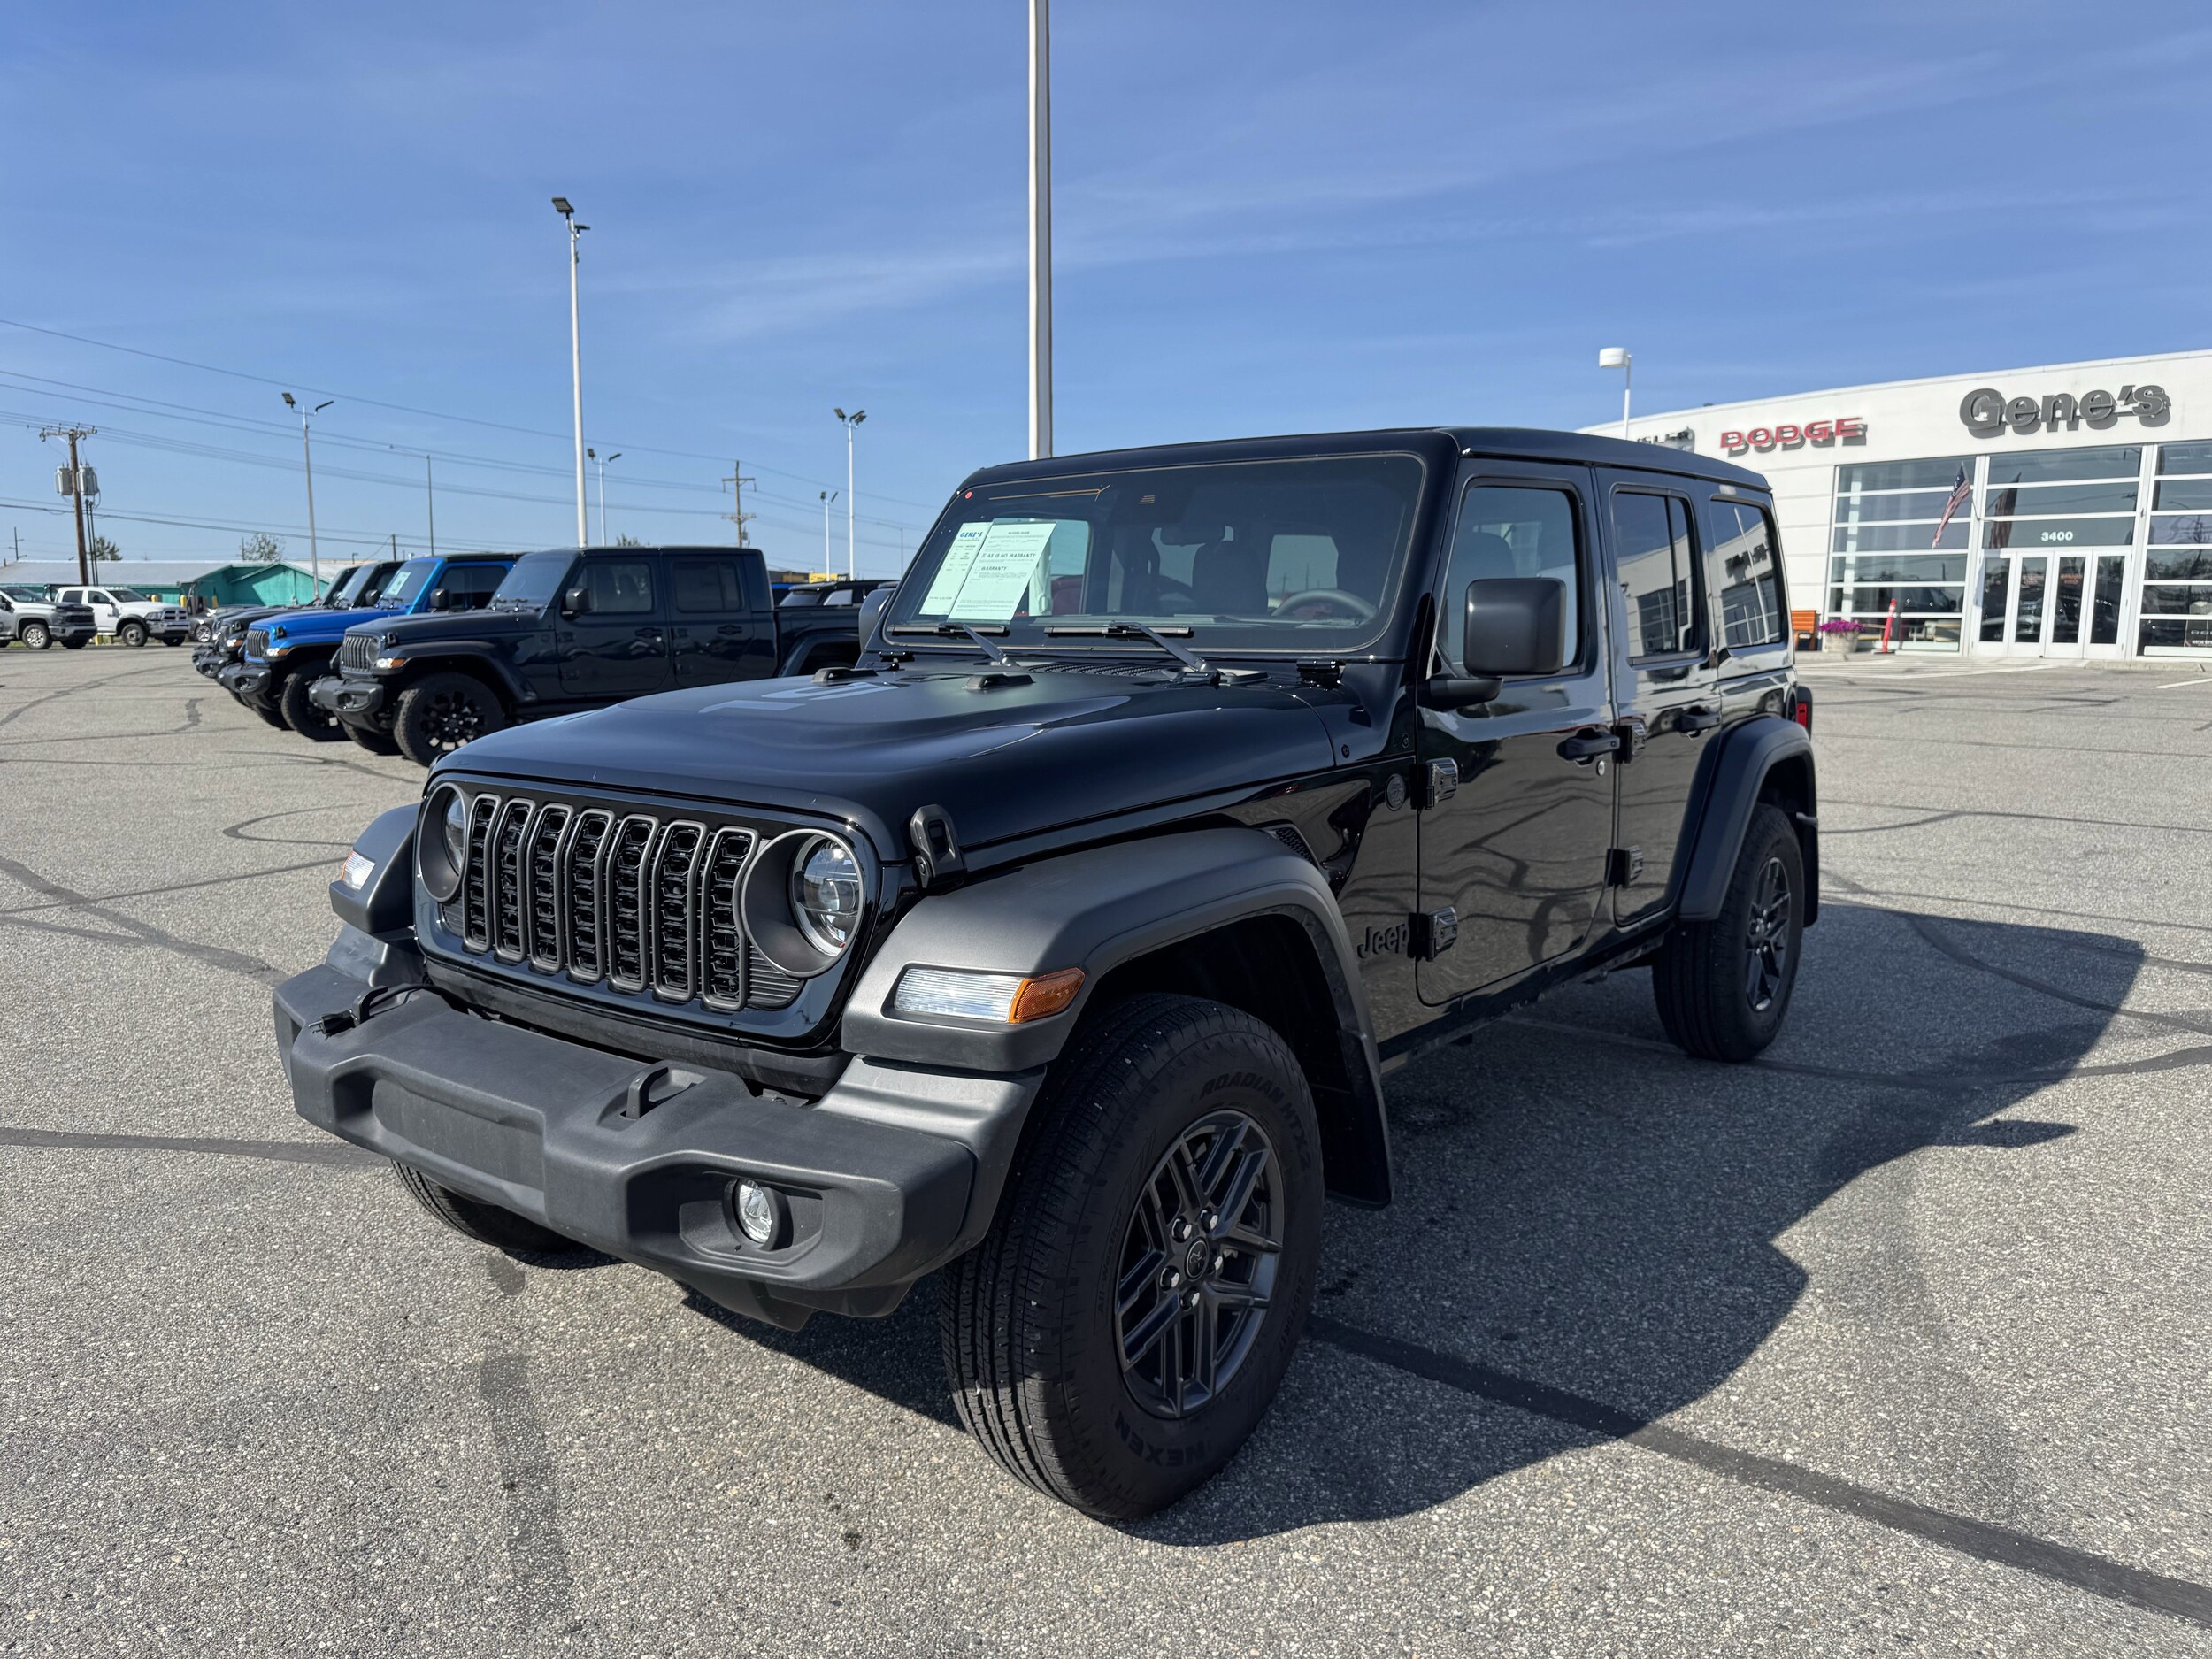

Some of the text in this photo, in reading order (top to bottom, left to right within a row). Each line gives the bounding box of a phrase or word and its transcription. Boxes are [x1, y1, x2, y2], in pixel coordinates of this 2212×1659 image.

[1959, 385, 2168, 429] Gene's
[1720, 417, 1863, 449] DODGE
[2040, 531, 2073, 541] 3400
[1356, 923, 1409, 959] Jeep
[1199, 1071, 1285, 1104] ROADIAN
[1114, 1410, 1205, 1467] NEXEN
